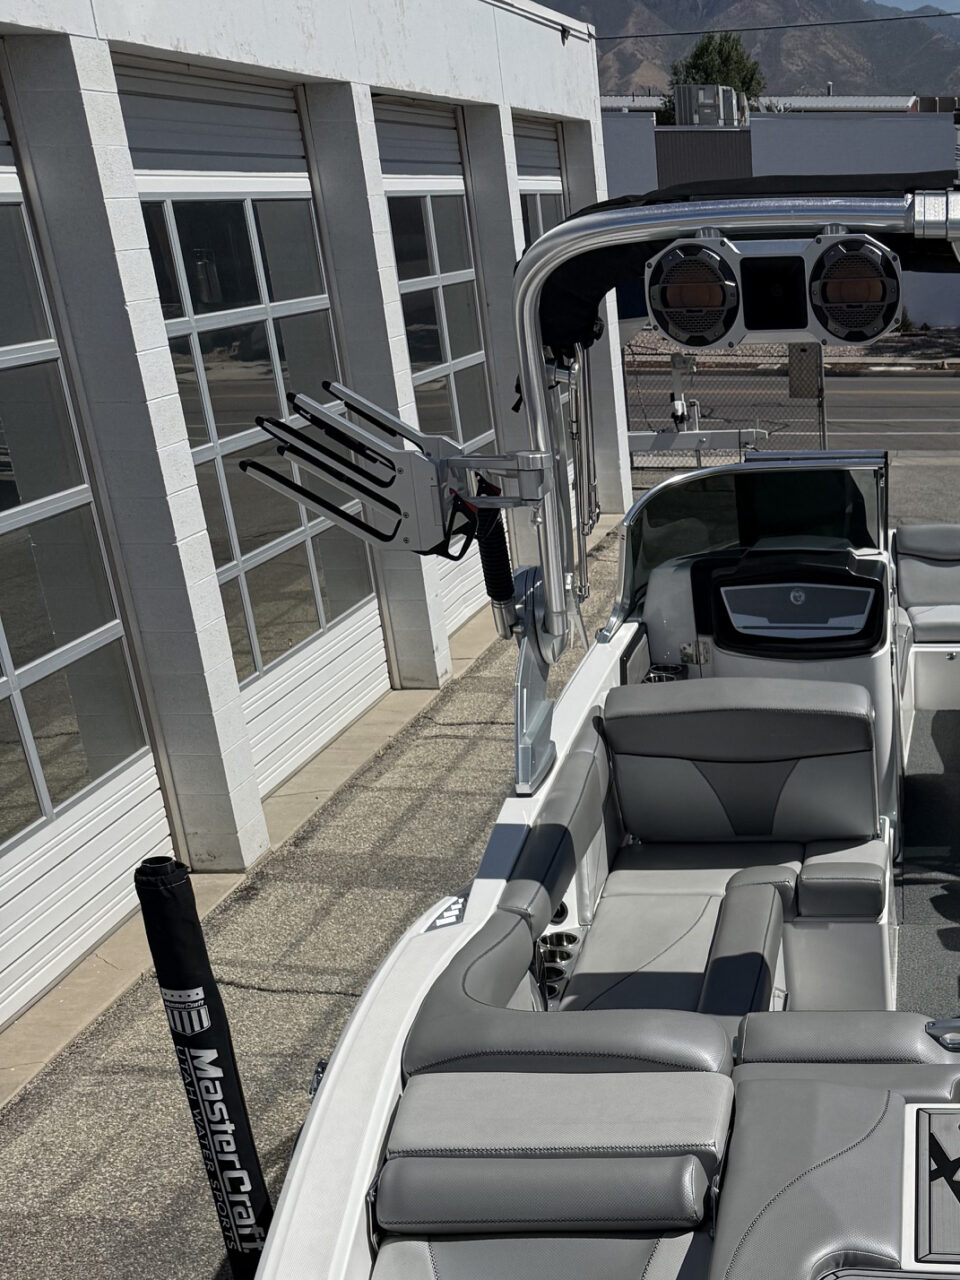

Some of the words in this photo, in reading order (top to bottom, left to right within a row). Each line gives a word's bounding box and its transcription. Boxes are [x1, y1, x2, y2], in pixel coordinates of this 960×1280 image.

[175, 1045, 198, 1100] UTAH
[193, 1108, 215, 1172] WATER
[210, 1180, 238, 1250] SPORTS
[189, 1048, 265, 1252] MasterCraft
